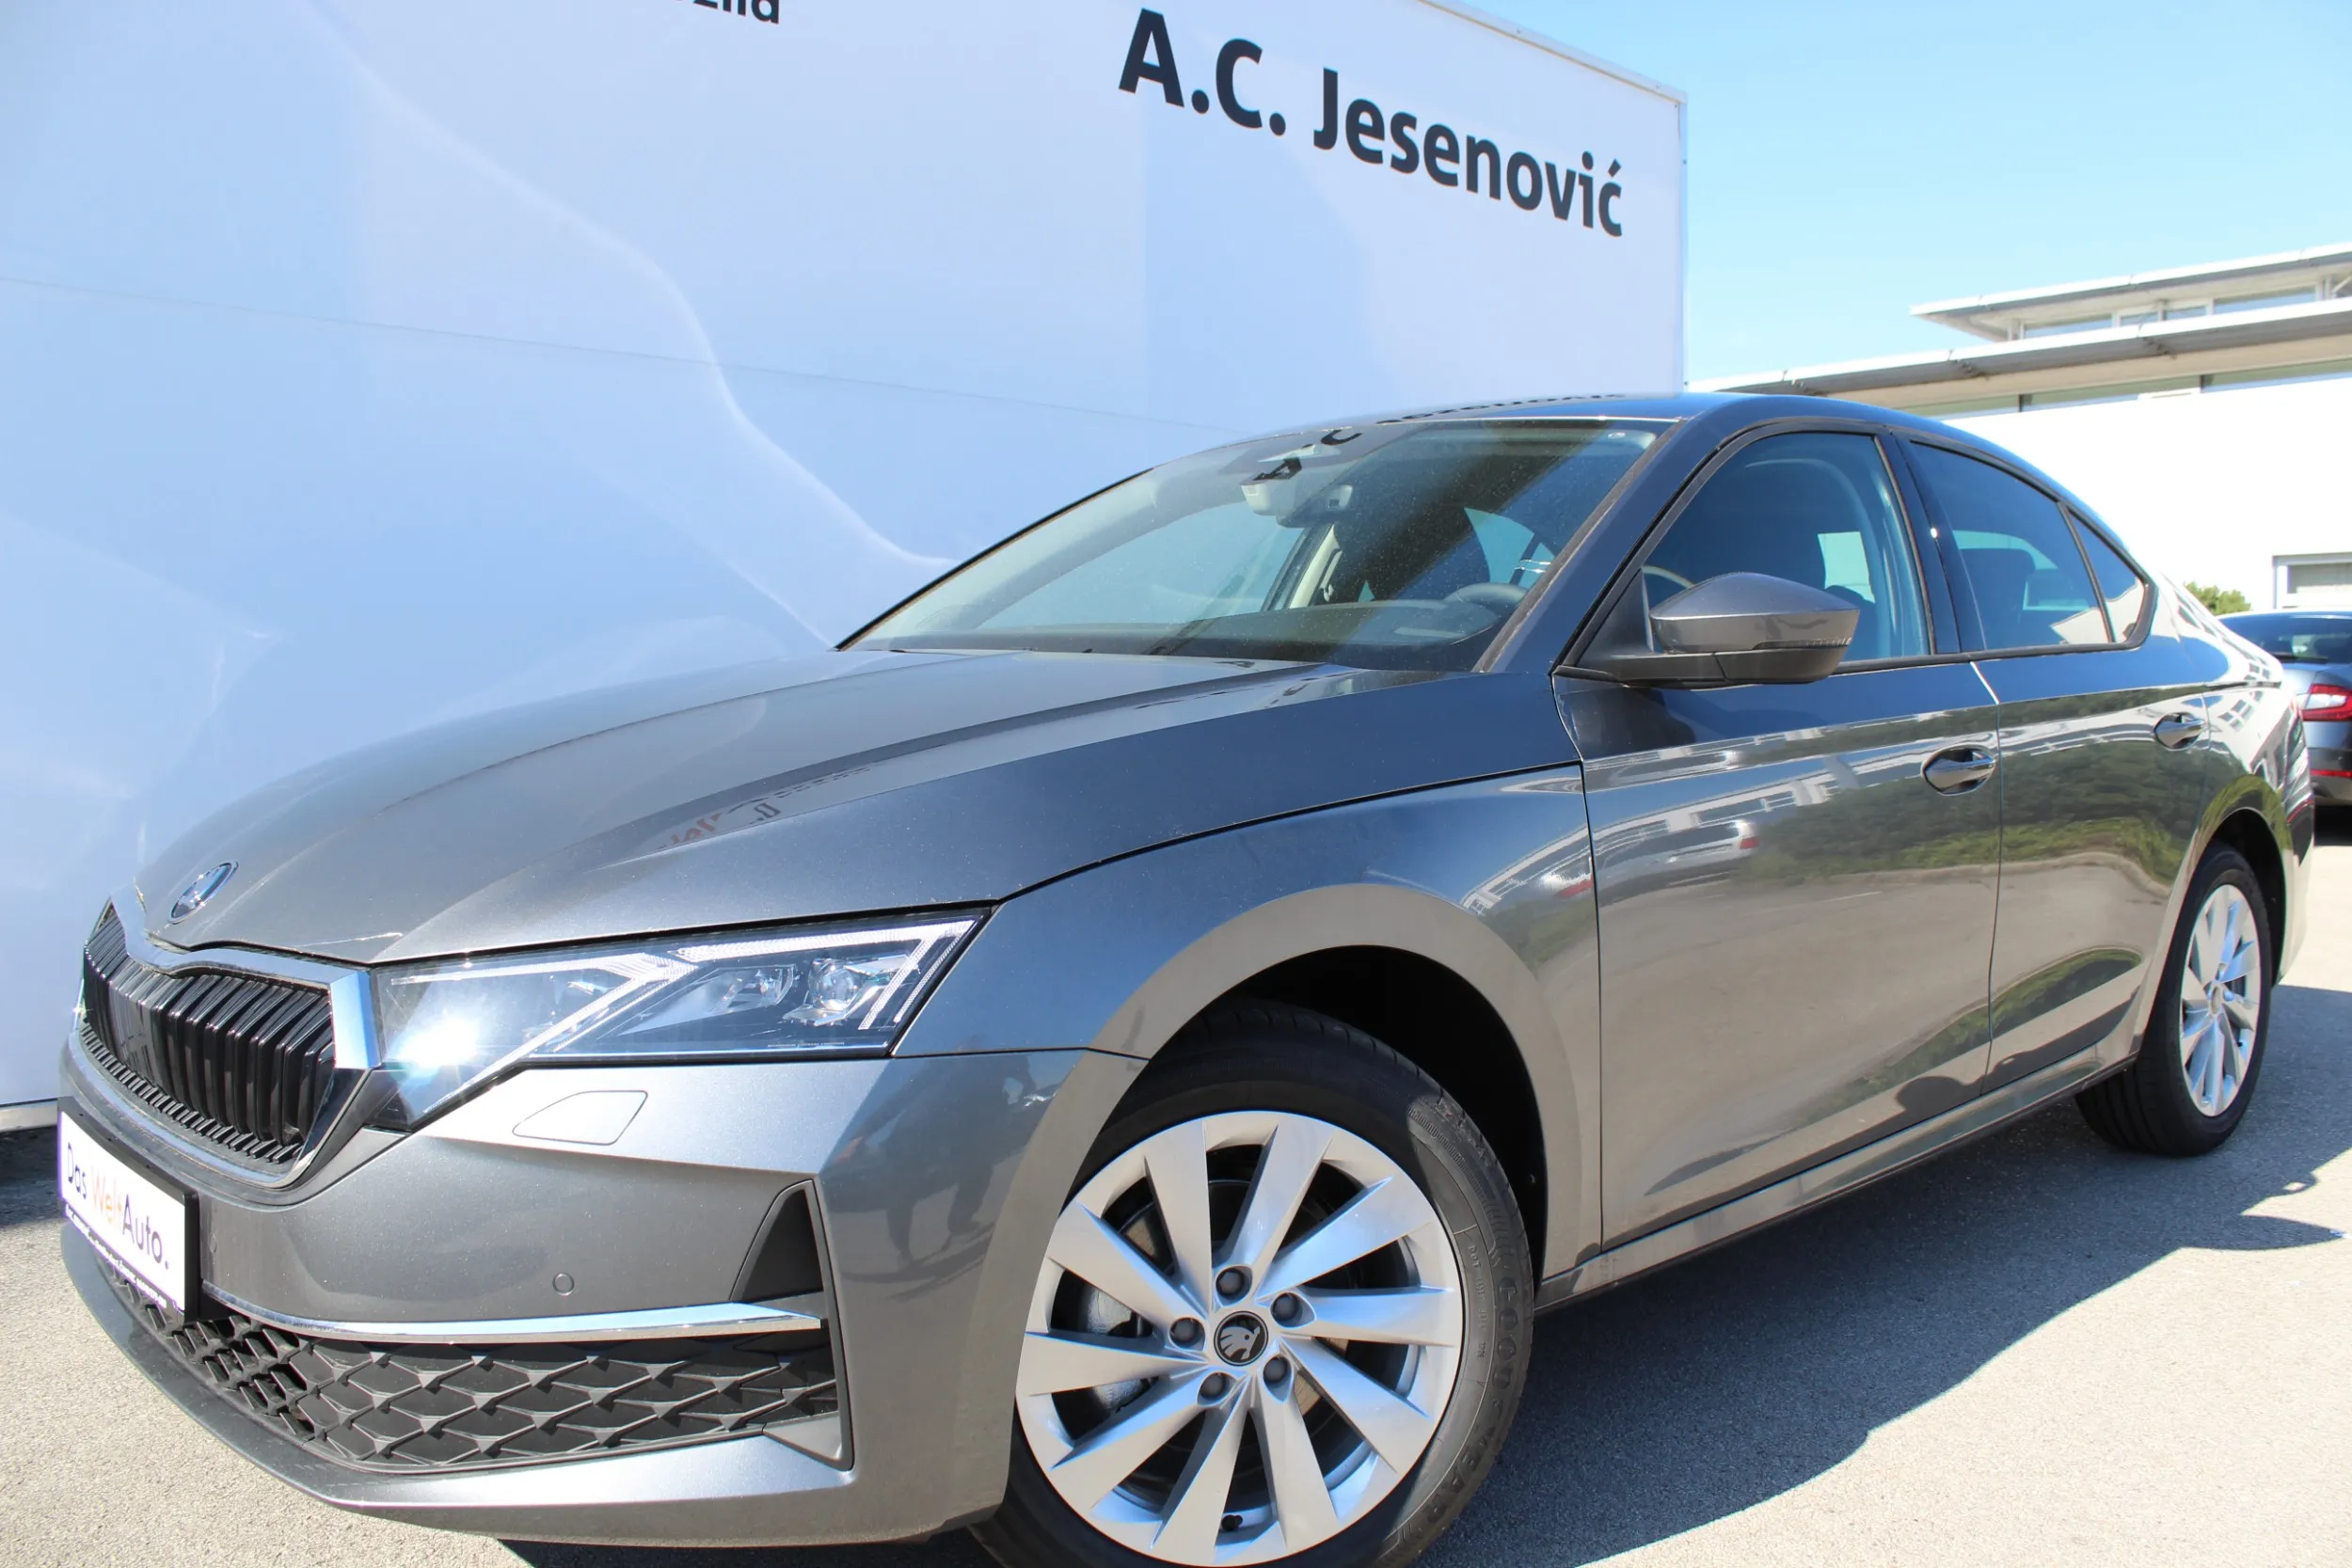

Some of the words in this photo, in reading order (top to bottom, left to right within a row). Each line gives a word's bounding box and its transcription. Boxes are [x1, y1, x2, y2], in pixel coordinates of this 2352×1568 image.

[1119, 8, 1286, 136] A.C.
[1313, 67, 1623, 237] Jesenović
[68, 1142, 87, 1199] Das
